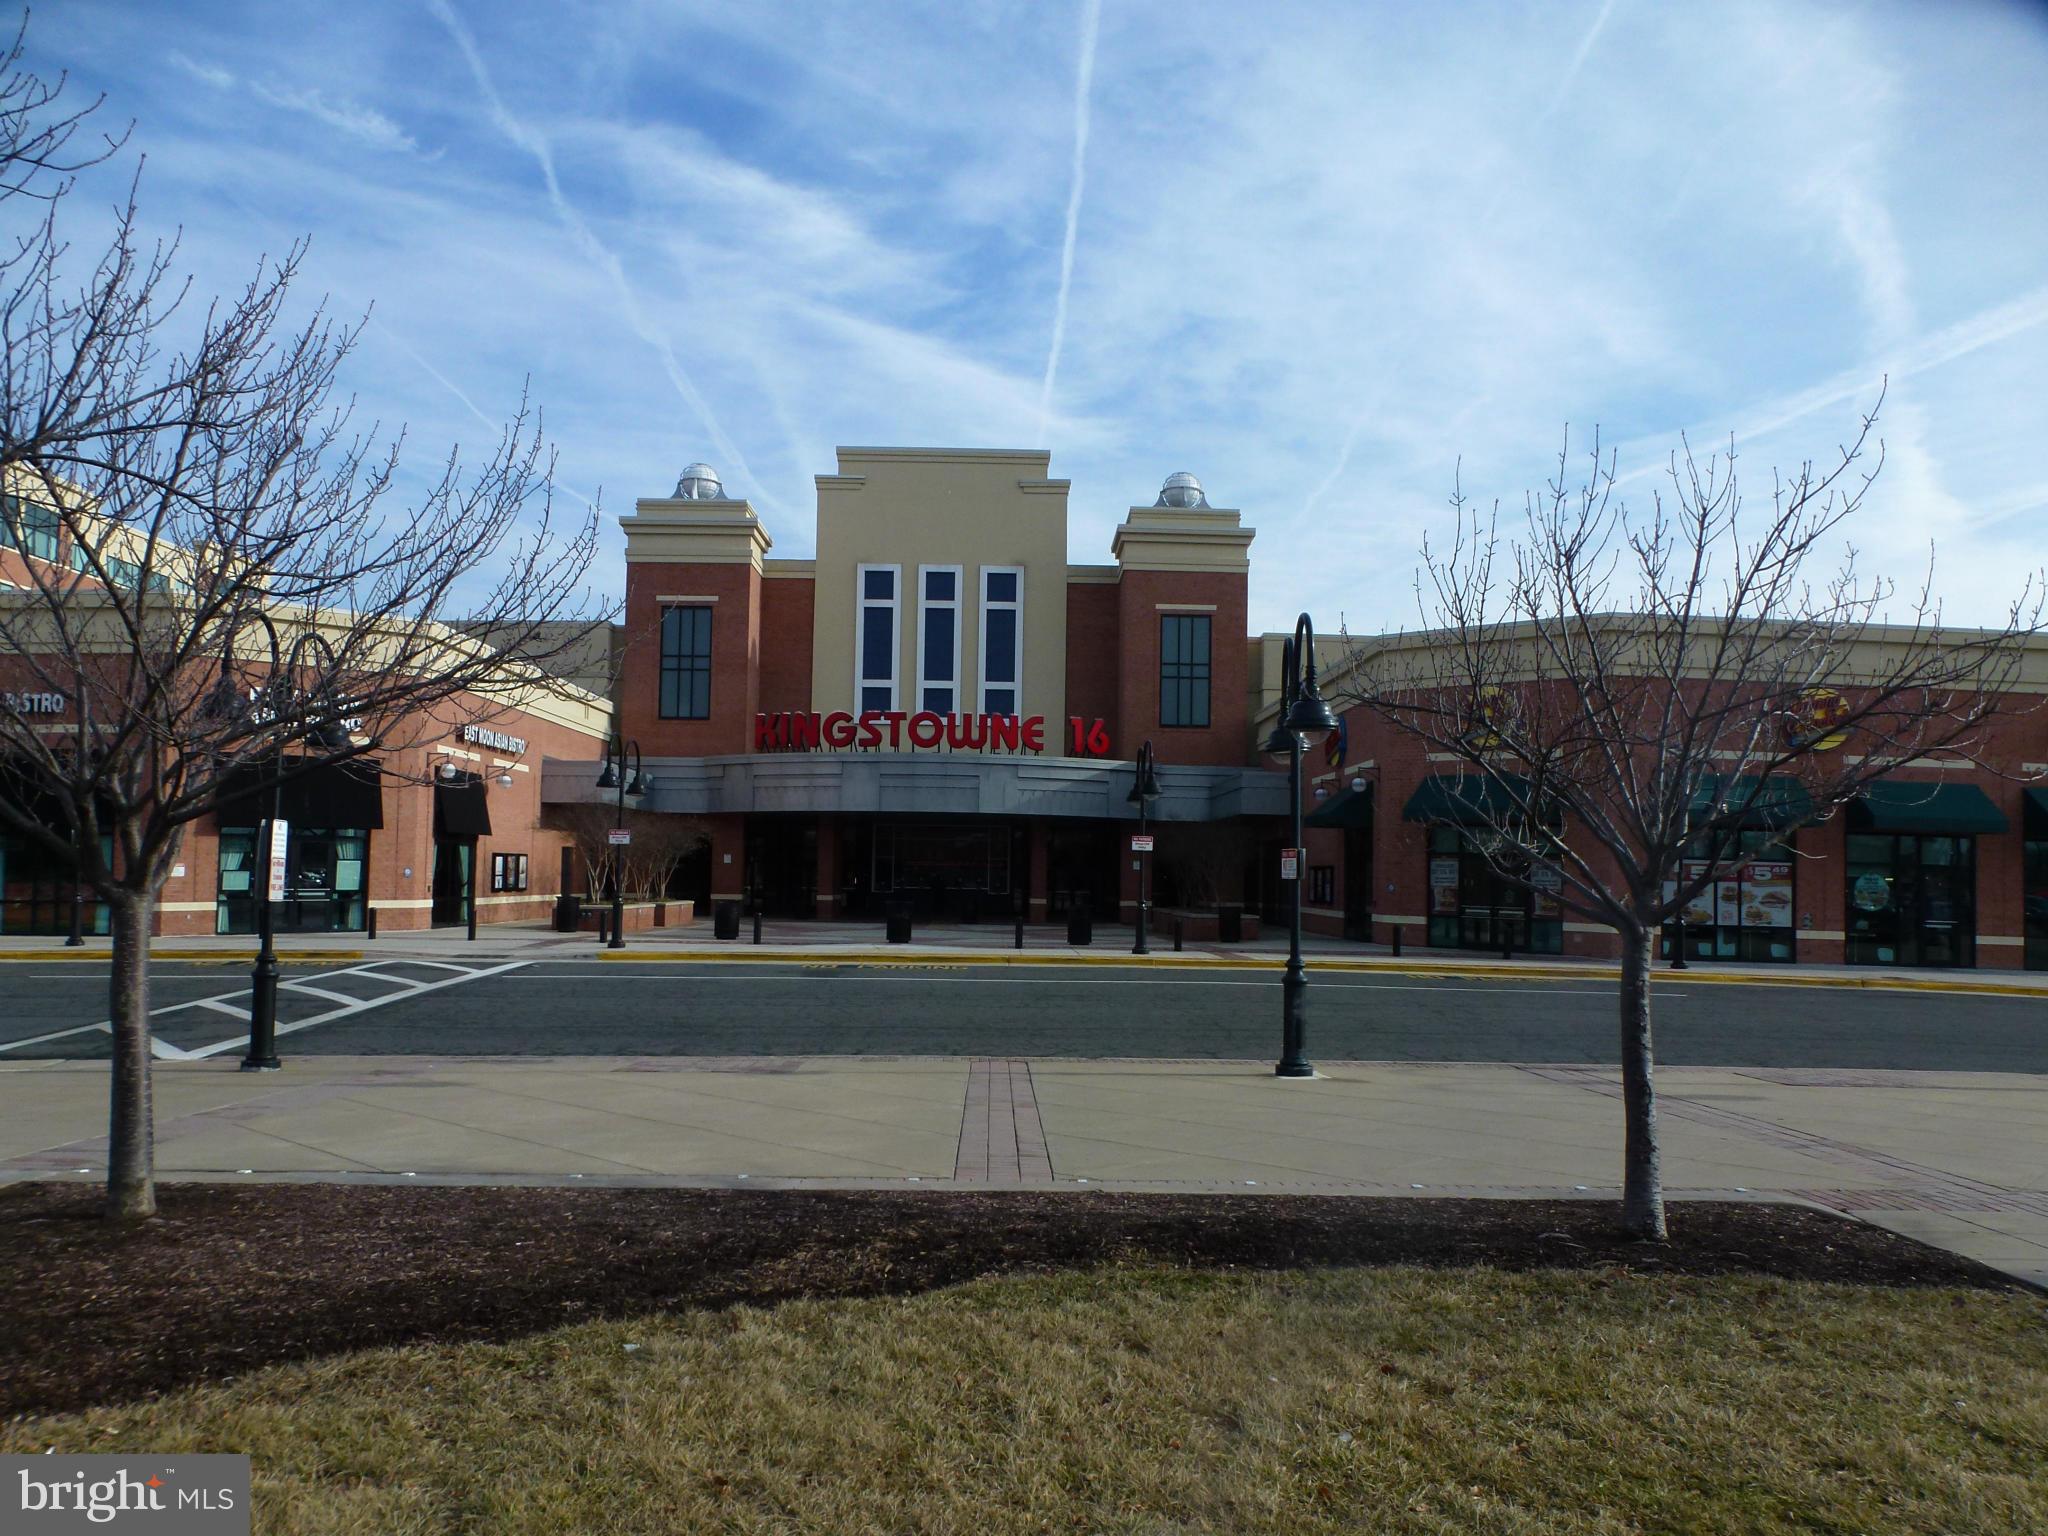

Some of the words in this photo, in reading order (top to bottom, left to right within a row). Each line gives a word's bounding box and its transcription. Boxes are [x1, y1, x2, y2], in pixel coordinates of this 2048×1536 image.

[464, 725, 478, 742] EAST
[479, 727, 494, 746] MOON
[494, 732, 508, 750] ASIAN
[509, 736, 525, 754] BISTRO
[754, 710, 1045, 751] KINGSTOWNE
[1069, 716, 1111, 754] 16
